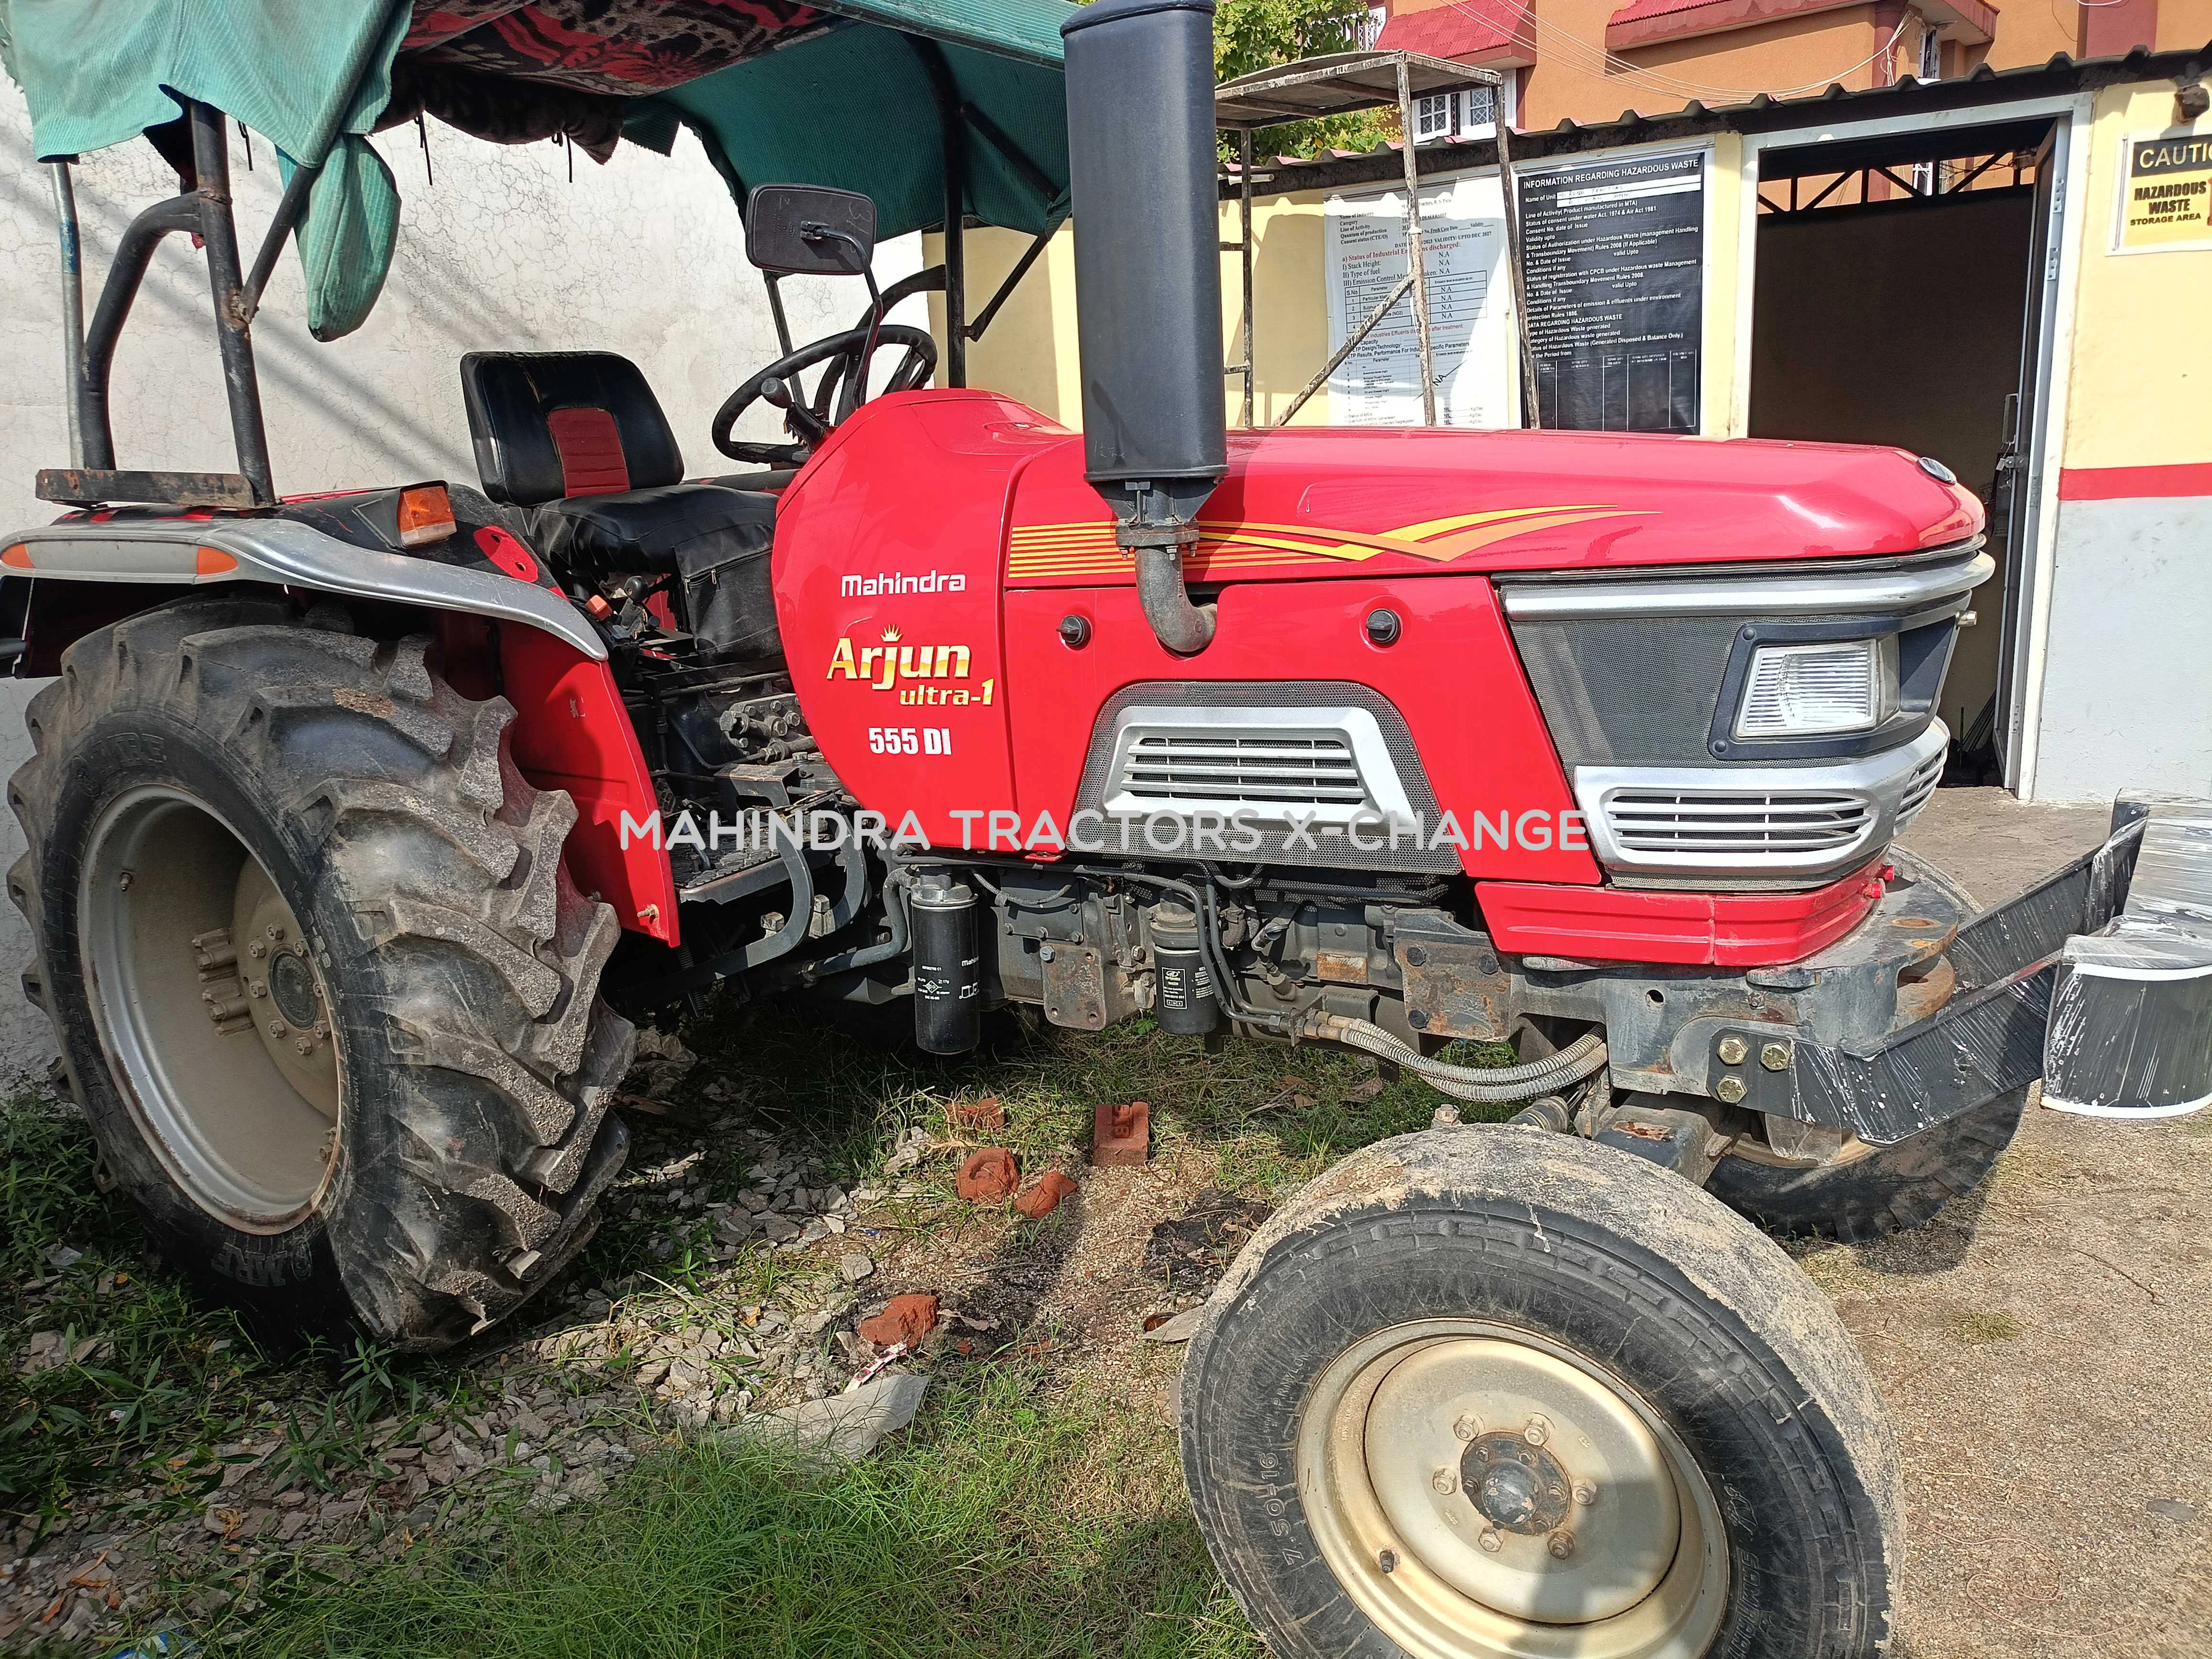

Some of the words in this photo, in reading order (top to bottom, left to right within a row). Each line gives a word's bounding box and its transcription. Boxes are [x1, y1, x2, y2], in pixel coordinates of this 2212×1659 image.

[1523, 176, 1573, 189] INFORMATION
[1575, 169, 1620, 182] REGARDING
[1621, 163, 1670, 176] HAZARDOUS
[1670, 159, 1698, 169] WASTE
[2134, 181, 2207, 200] HAZARDOUS
[1583, 202, 1618, 211] manufactured
[2148, 199, 2190, 215] WASTE
[2130, 216, 2173, 226] STORAGE
[2176, 213, 2201, 221] AREA
[1639, 229, 1674, 238] (management
[1373, 250, 1399, 258] Industrial
[1429, 242, 1461, 251] discharged:
[1628, 238, 1657, 247] Applicable)
[1353, 277, 1375, 286] Emission
[1376, 275, 1395, 283] Control
[841, 569, 966, 597] Mahindra
[827, 637, 971, 691] Arjun
[900, 678, 995, 706] ultra-1
[868, 727, 919, 754] 555
[923, 728, 952, 755] DI
[1259, 1452, 1305, 1565] 7.50-16
